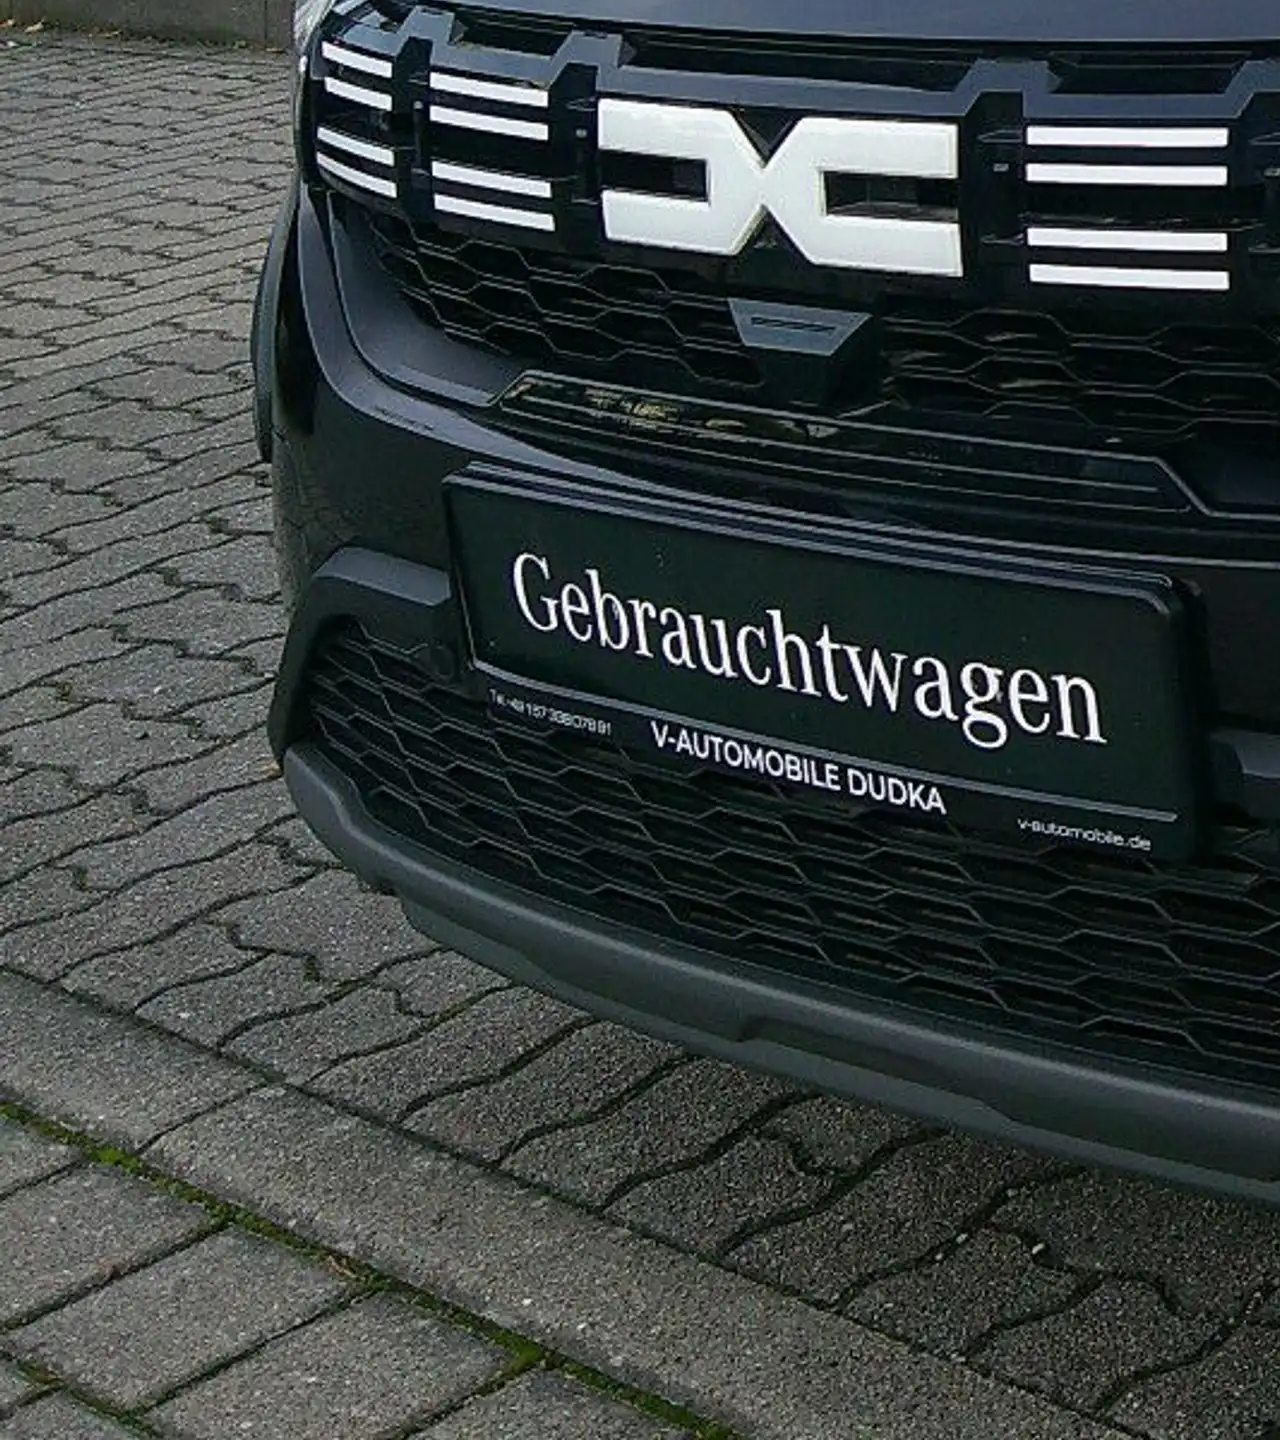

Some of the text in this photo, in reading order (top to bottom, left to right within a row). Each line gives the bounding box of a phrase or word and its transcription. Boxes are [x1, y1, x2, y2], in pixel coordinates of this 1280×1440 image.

[512, 551, 1108, 750] Gebrauchtwagen
[649, 720, 947, 815] V-AUTOMOBILE DUDKA
[1016, 817, 1151, 851] v-automobile.de
